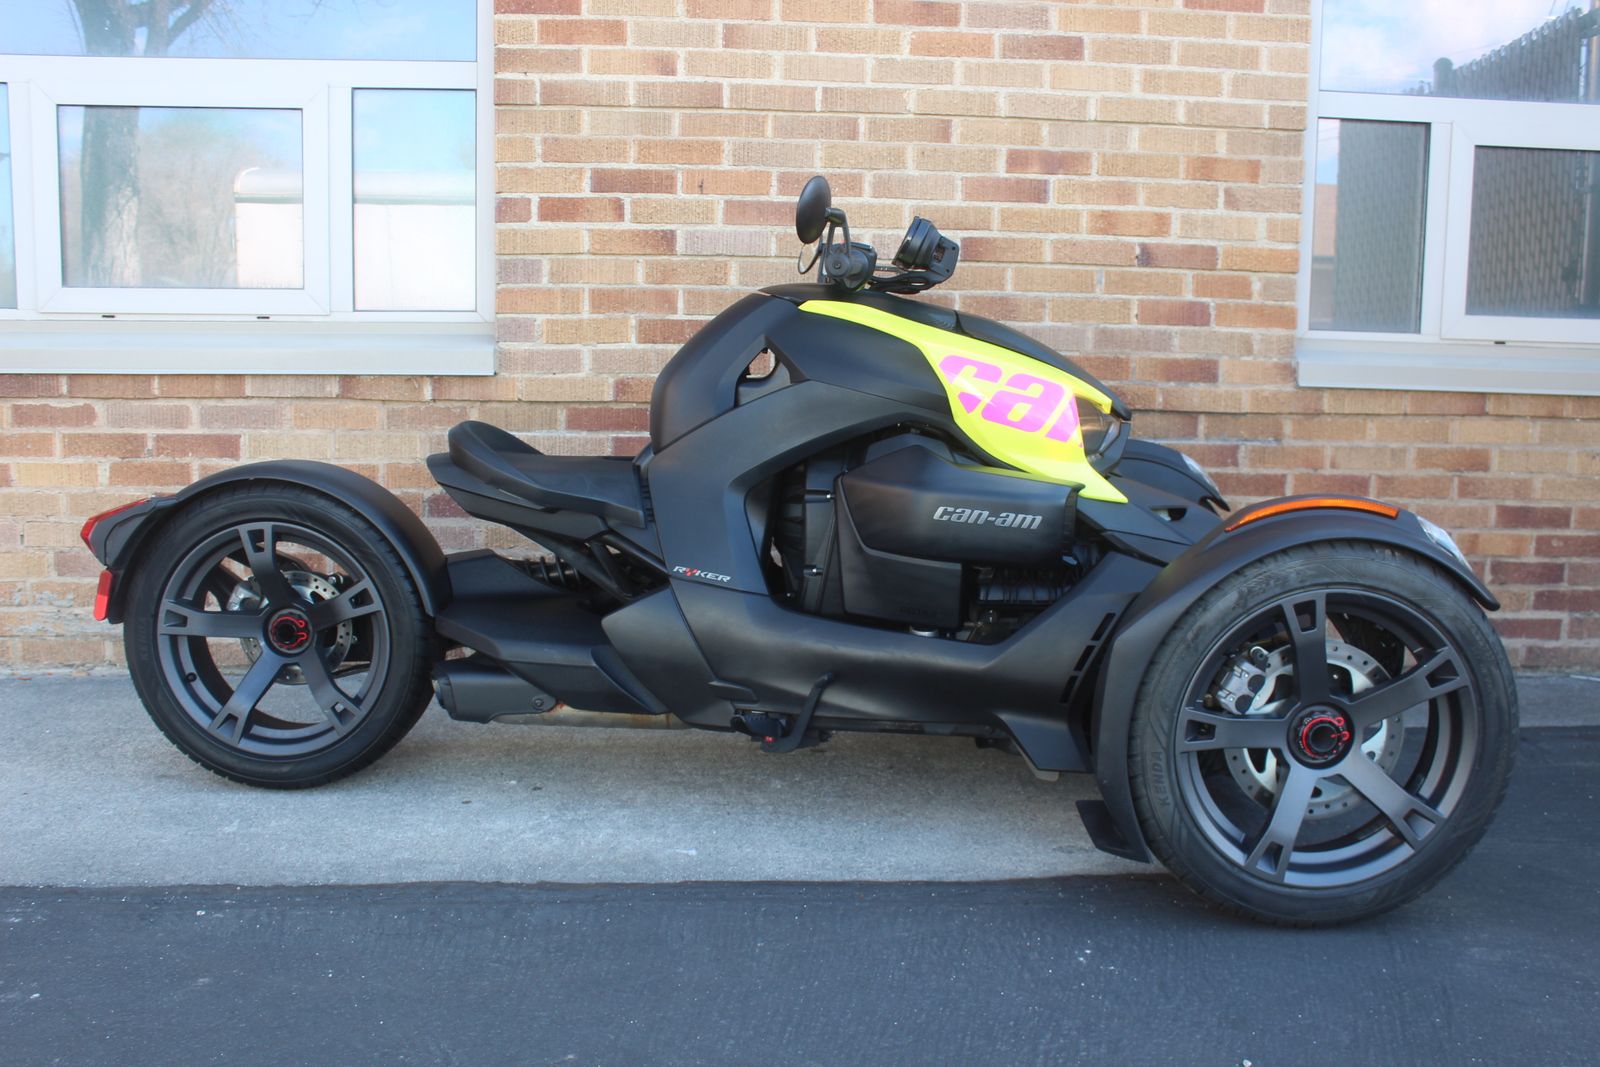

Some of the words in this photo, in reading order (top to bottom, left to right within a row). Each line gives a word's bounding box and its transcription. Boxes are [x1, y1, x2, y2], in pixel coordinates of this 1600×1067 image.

[933, 506, 1042, 529] can-am
[673, 566, 731, 582] RYKER
[1151, 751, 1171, 807] KENDA
